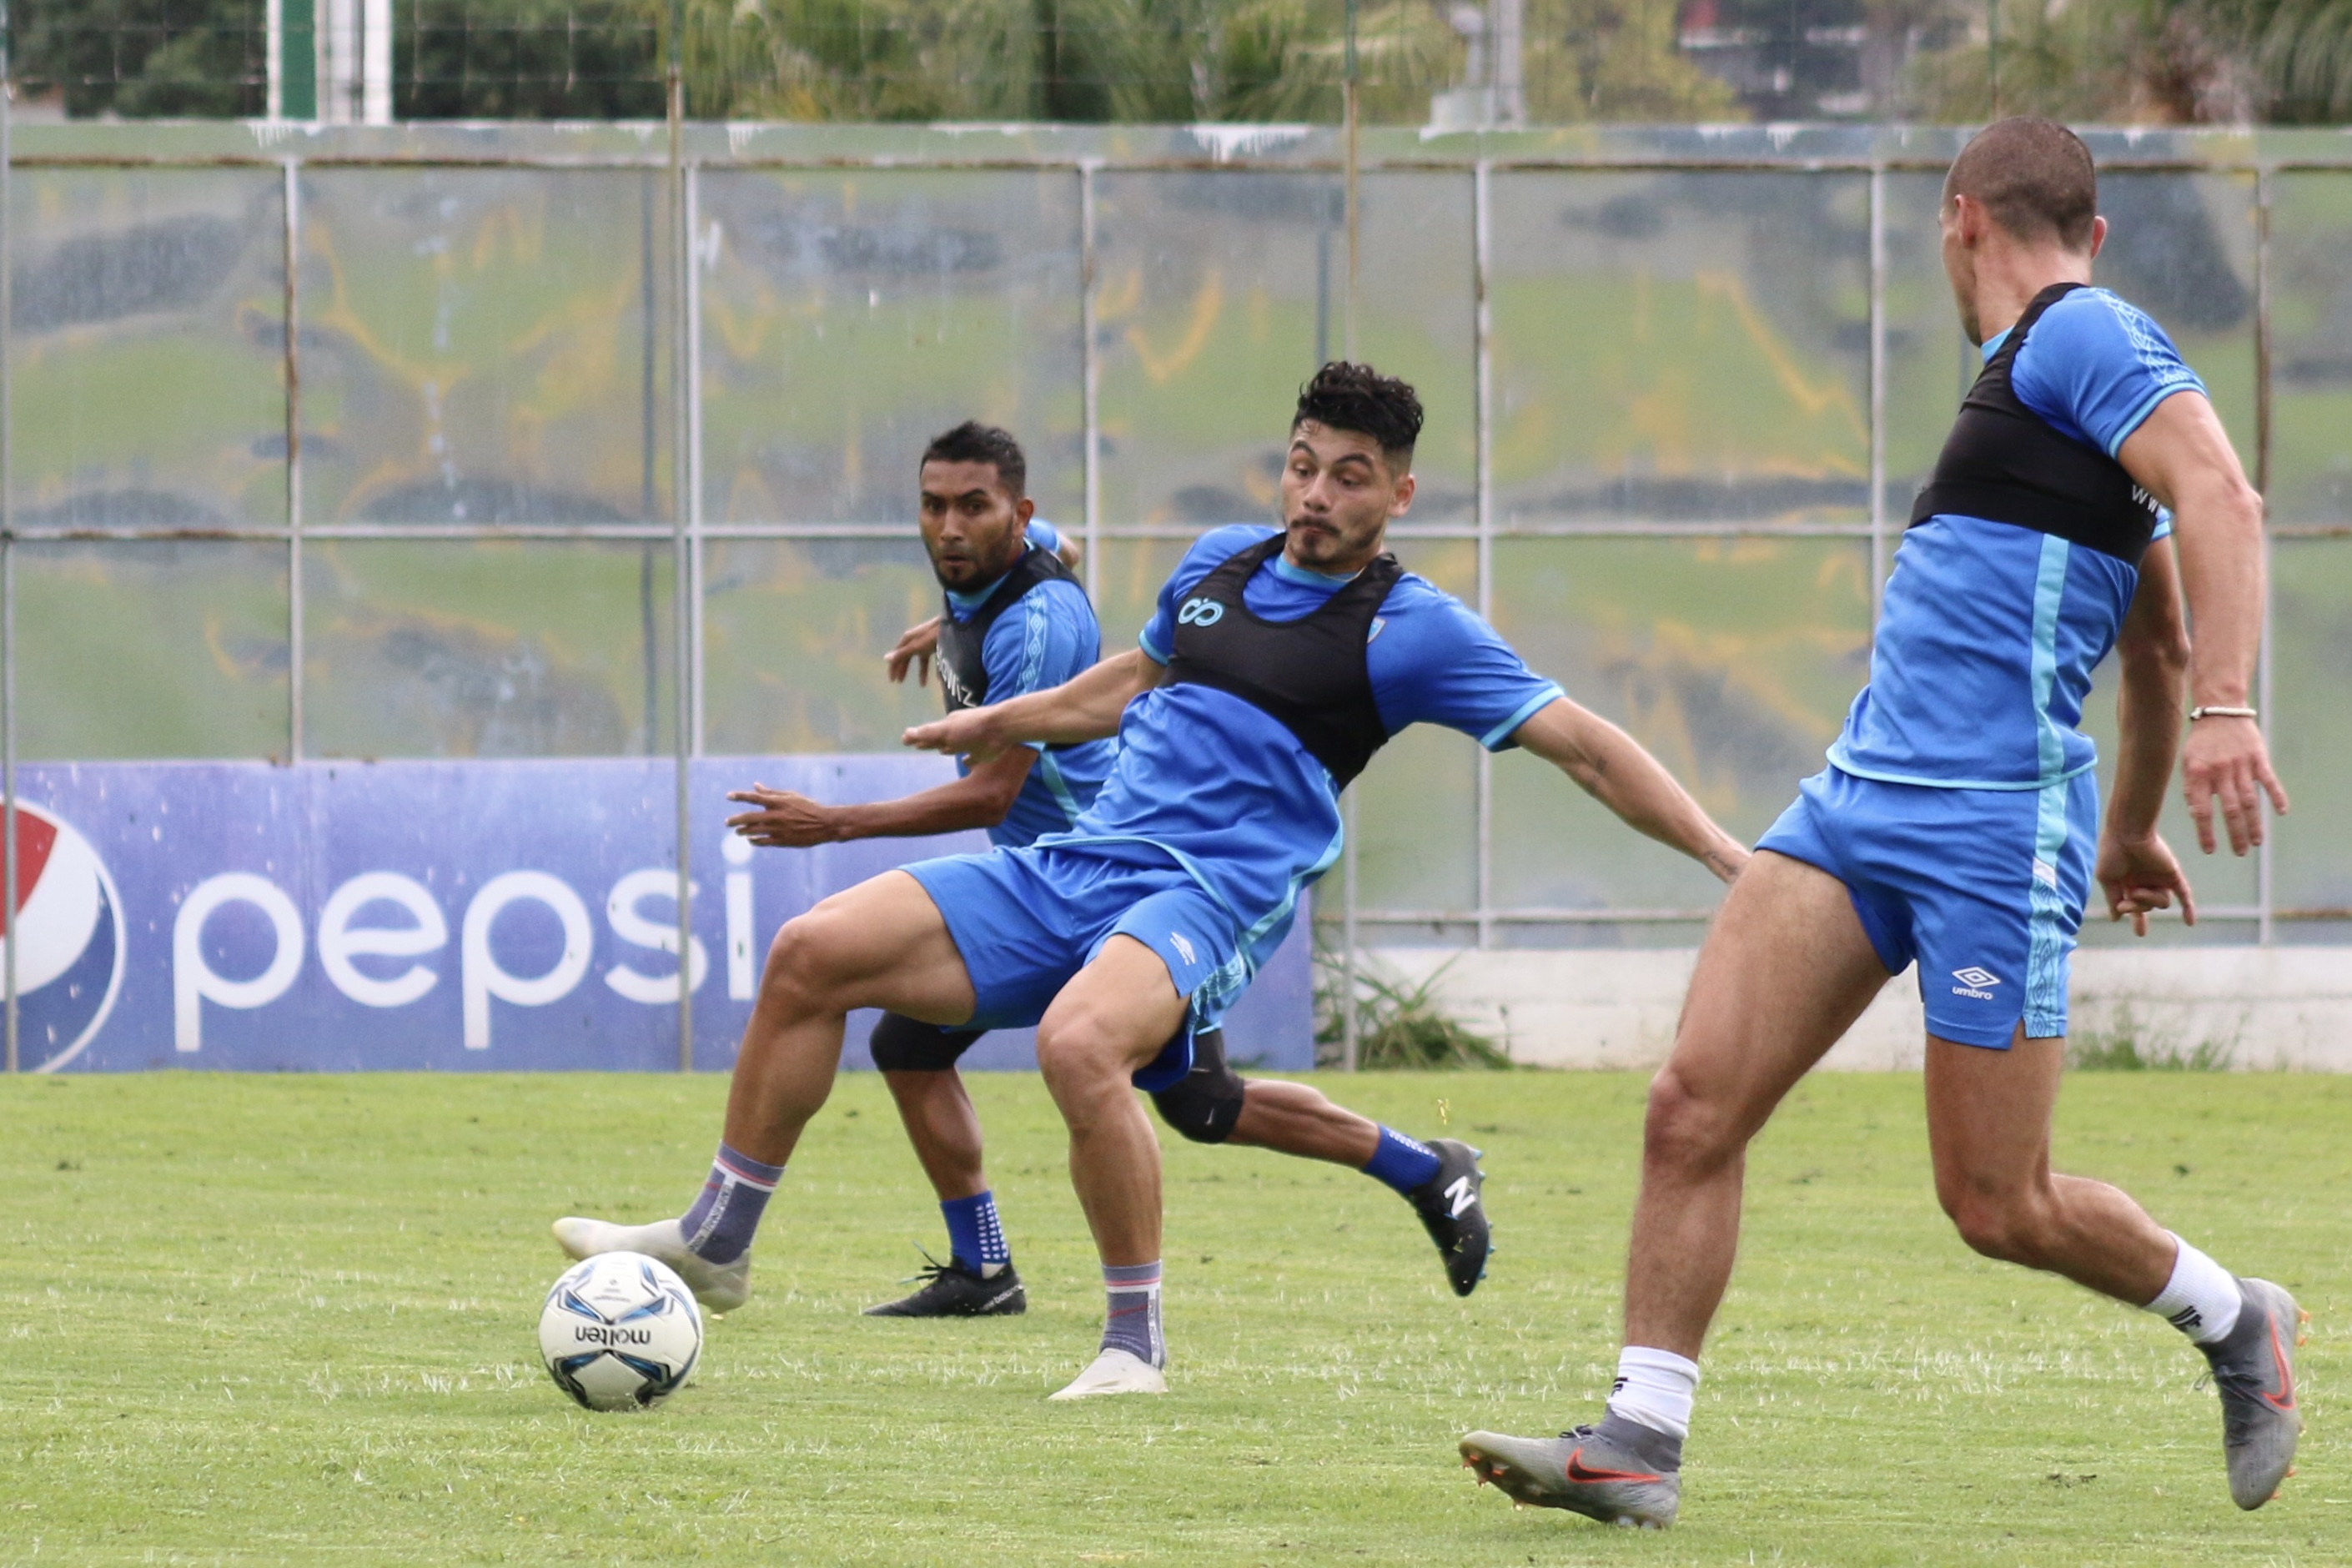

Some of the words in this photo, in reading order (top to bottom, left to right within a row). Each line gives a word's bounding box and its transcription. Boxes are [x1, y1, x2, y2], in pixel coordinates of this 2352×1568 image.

[173, 828, 754, 1052] pepsi
[1952, 985, 1993, 1001] umbro
[1443, 1175, 1475, 1217] N
[575, 1326, 651, 1346] molten
